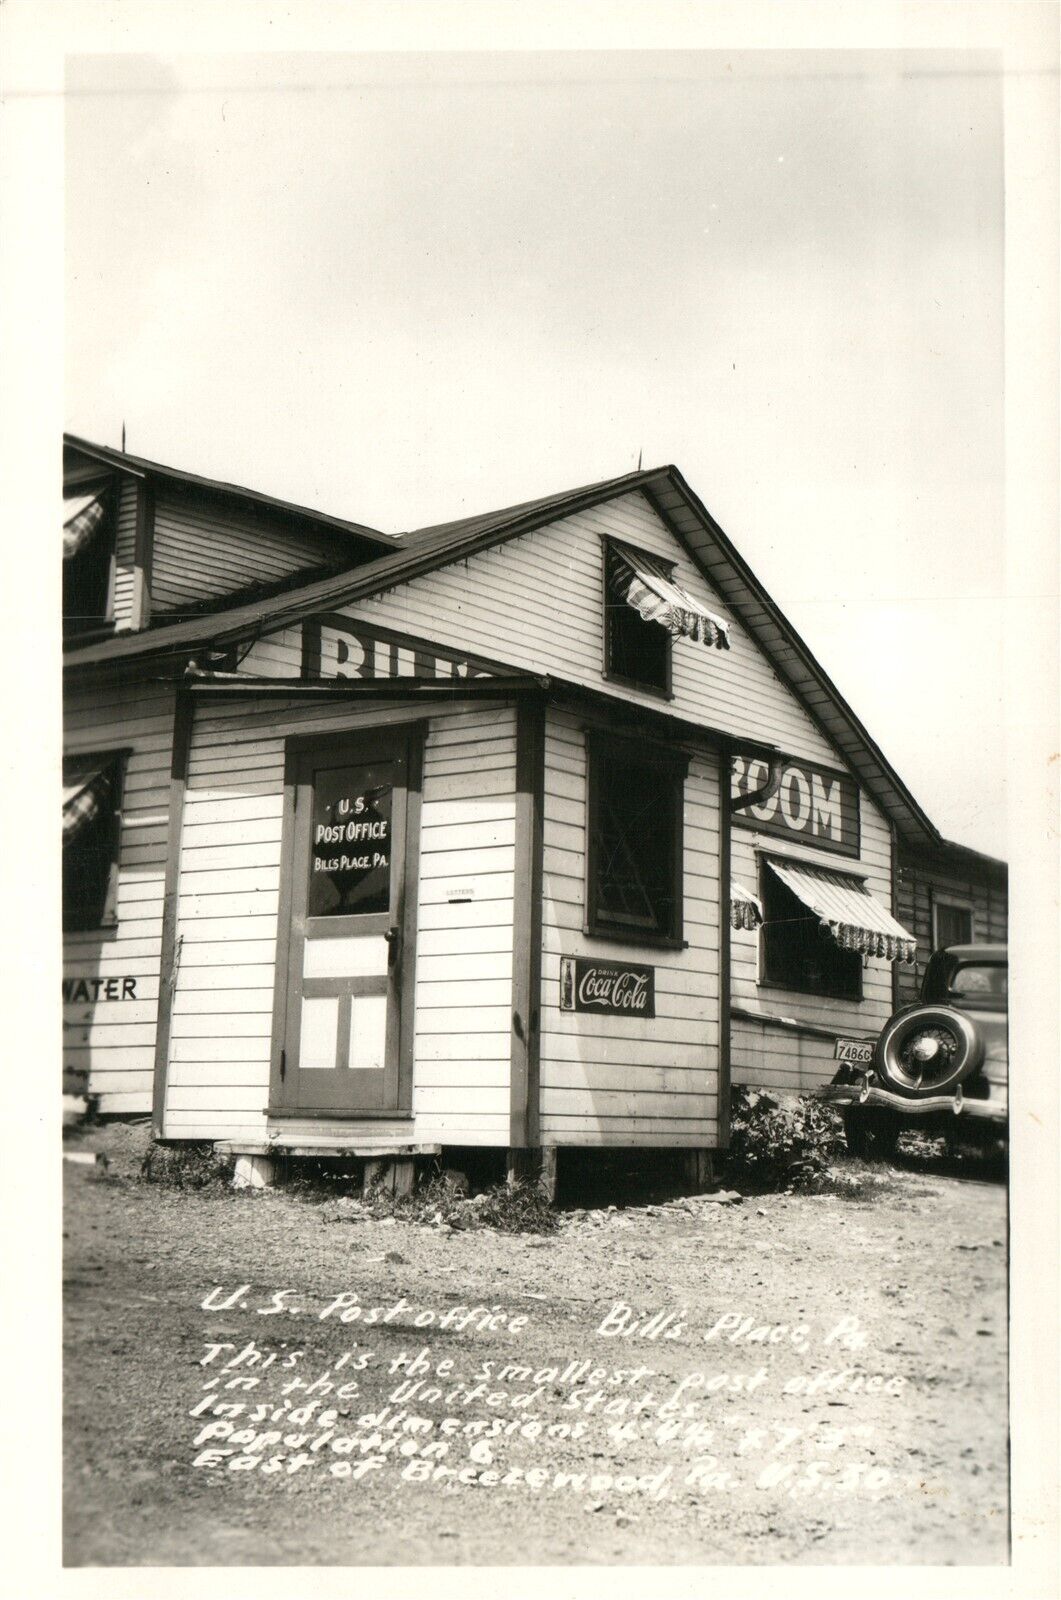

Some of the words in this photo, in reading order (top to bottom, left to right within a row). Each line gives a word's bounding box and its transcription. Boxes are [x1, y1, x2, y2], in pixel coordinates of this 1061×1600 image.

[338, 797, 369, 815] U.S.
[315, 824, 345, 845] POST
[346, 821, 387, 842] OFFICE
[314, 857, 339, 872] BILL'S
[597, 969, 619, 977] DRINK
